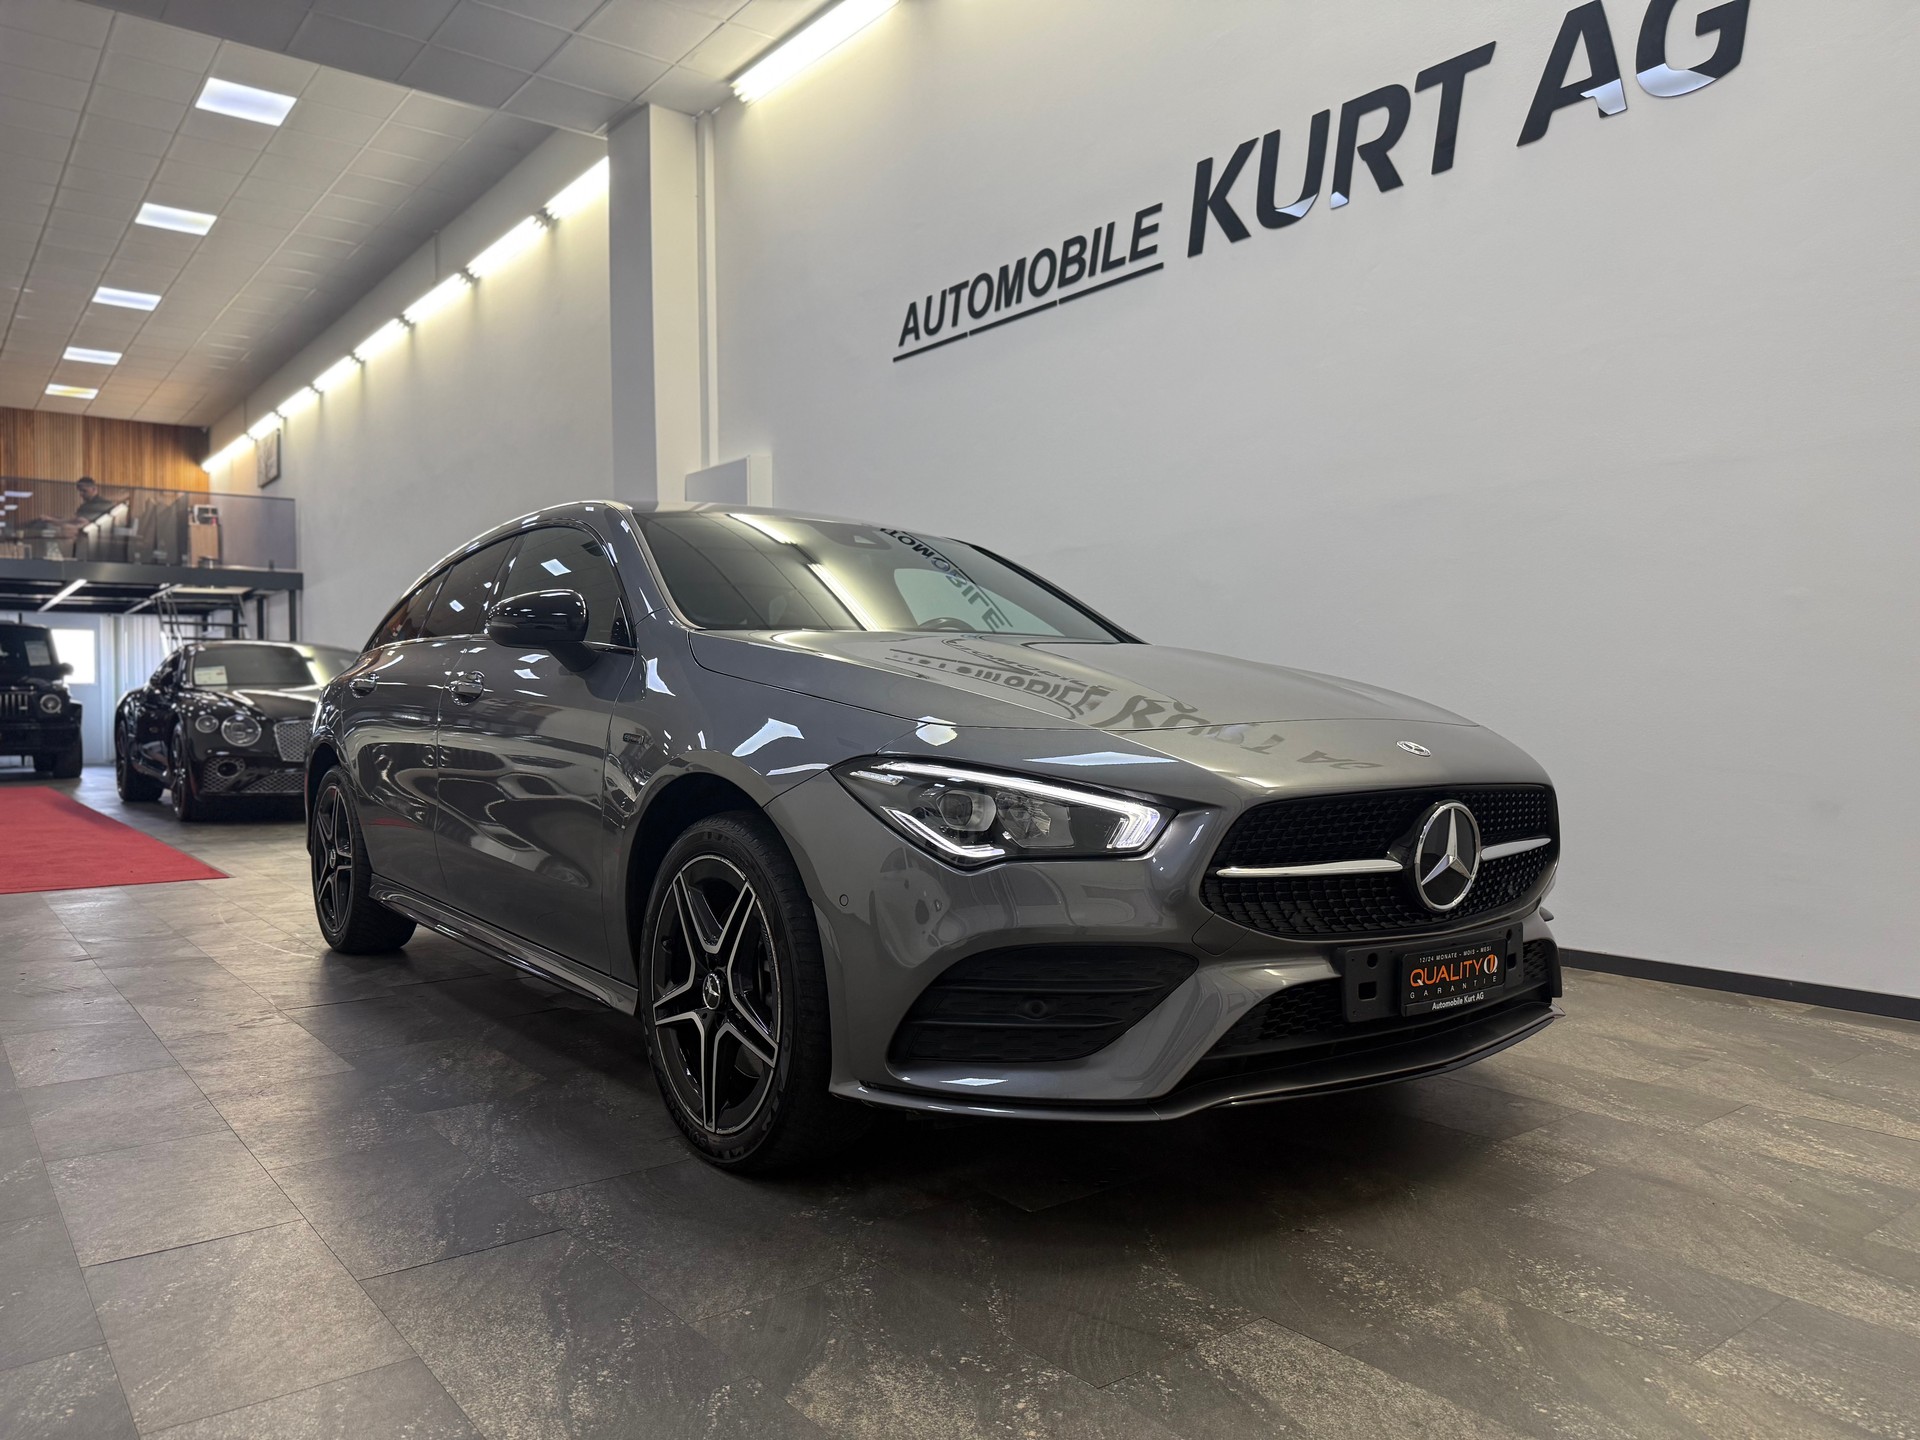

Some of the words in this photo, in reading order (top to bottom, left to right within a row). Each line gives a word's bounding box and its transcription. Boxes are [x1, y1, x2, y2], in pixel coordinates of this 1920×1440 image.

[898, 202, 1163, 347] AUTOMOBILE
[1187, 41, 1496, 258] KURT
[1516, 0, 1750, 146] AG
[1436, 952, 1457, 960] MONATE
[1463, 948, 1475, 956] MOIS
[1410, 957, 1483, 987] QUALITY
[1410, 975, 1497, 999] GARANTIE
[1432, 997, 1463, 1010] Automobile
[1463, 992, 1475, 1003] Kurt
[1476, 991, 1484, 1000] AG
